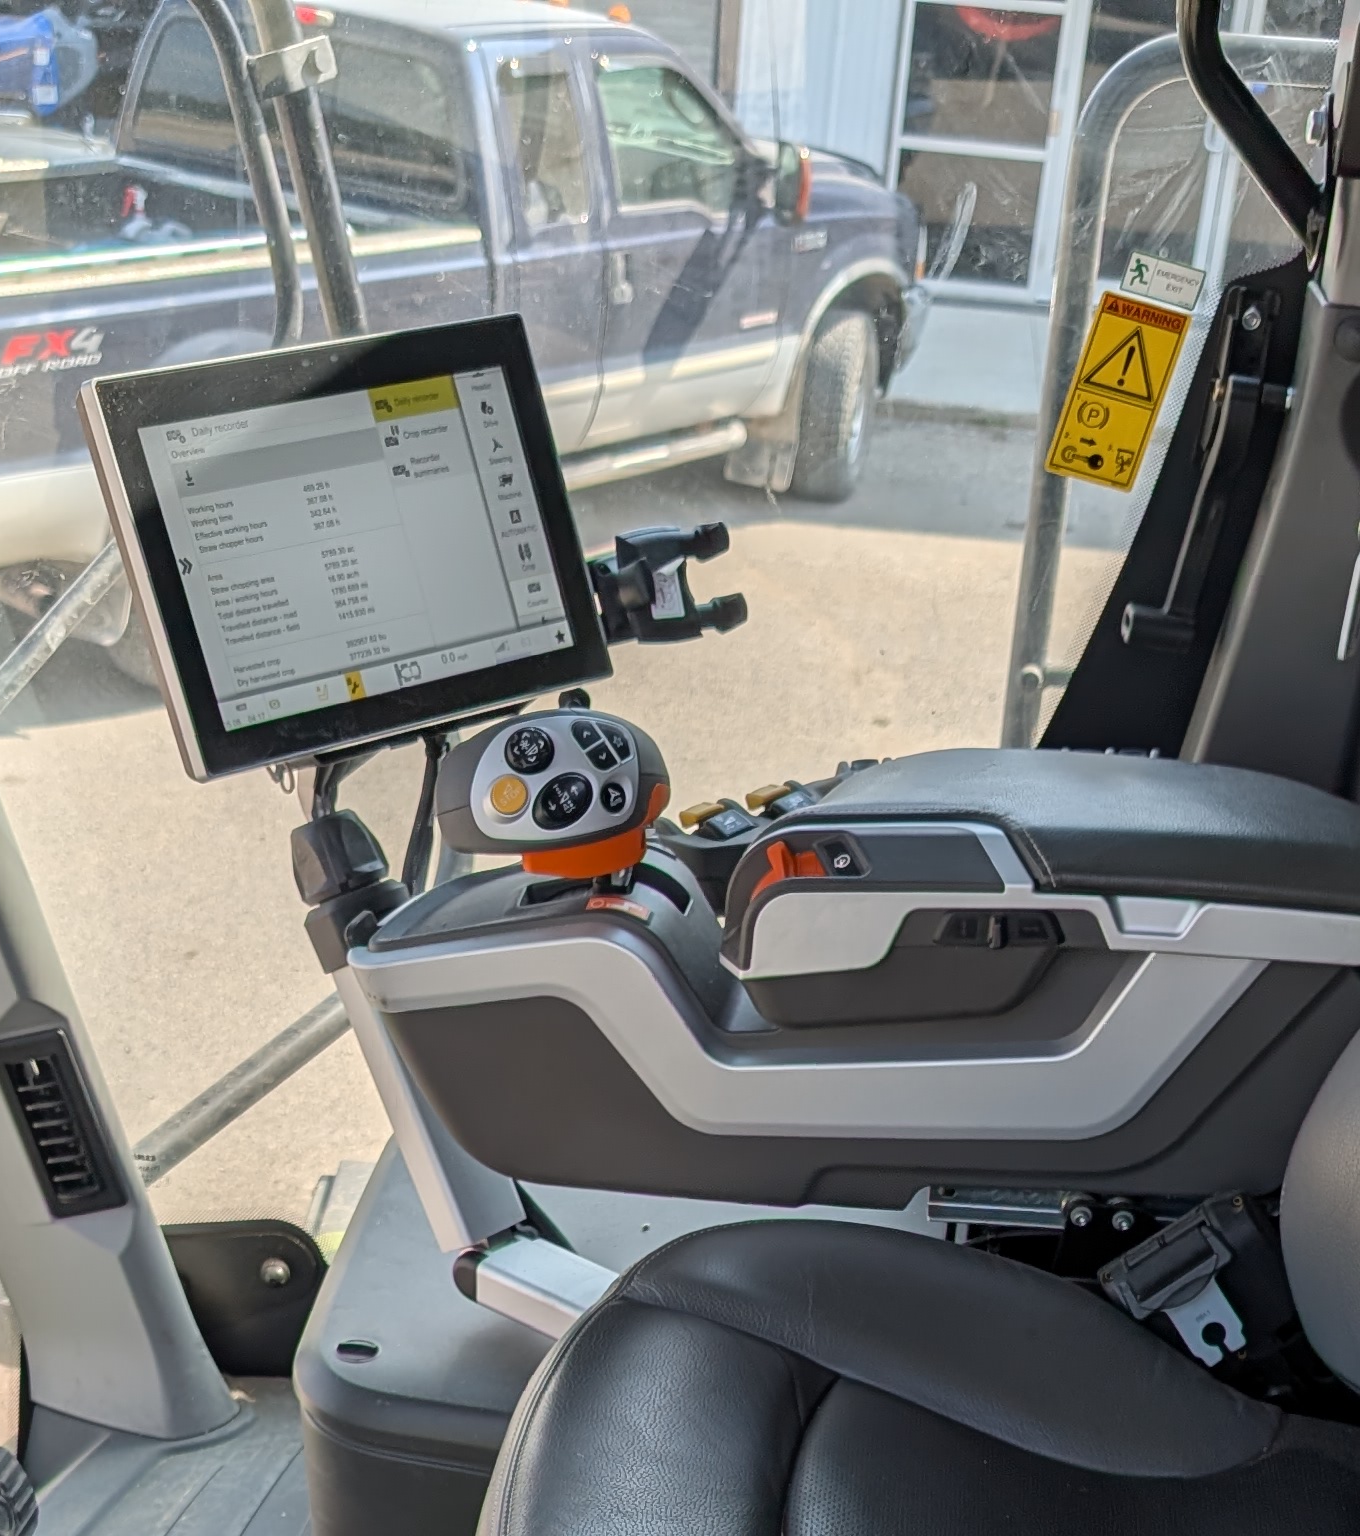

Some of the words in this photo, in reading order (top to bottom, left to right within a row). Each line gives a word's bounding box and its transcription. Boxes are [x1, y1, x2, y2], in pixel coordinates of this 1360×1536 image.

[1156, 268, 1201, 288] EMERGENCY
[1165, 282, 1184, 295] EXIT
[1122, 302, 1182, 330] WARNING
[1, 326, 105, 366] FX4
[40, 351, 103, 373] ROAD
[191, 424, 215, 438] Daily
[214, 418, 249, 433] recorder
[403, 430, 420, 440] Crop
[420, 424, 448, 436] recorder
[171, 446, 206, 459] Overview
[410, 452, 440, 466] Recorder
[187, 503, 217, 516] Working
[217, 500, 234, 509] hours
[191, 516, 219, 529] Working
[219, 514, 233, 522] time
[195, 529, 223, 541] Effective
[224, 524, 249, 536] working
[249, 520, 267, 530] hours
[199, 544, 217, 554] Straw
[218, 538, 246, 552] chopper
[245, 534, 264, 544] hours
[207, 572, 223, 582] Area
[211, 585, 229, 595] Straw
[230, 578, 260, 593] chopping
[260, 576, 275, 584] area
[214, 598, 231, 608] Area
[234, 592, 260, 605] working
[260, 588, 278, 597] hours
[218, 611, 235, 620] Total
[235, 605, 262, 617] distance
[262, 599, 289, 611] travelled
[222, 620, 251, 634] Travelled
[252, 615, 278, 627] distance
[226, 633, 255, 646] Travelled
[255, 627, 281, 640] distance
[234, 660, 266, 675] Harvested
[266, 658, 281, 668] crop
[441, 654, 455, 664] 0.0
[237, 678, 250, 689] Dry
[249, 670, 281, 685] harvested
[281, 668, 296, 678] crop
